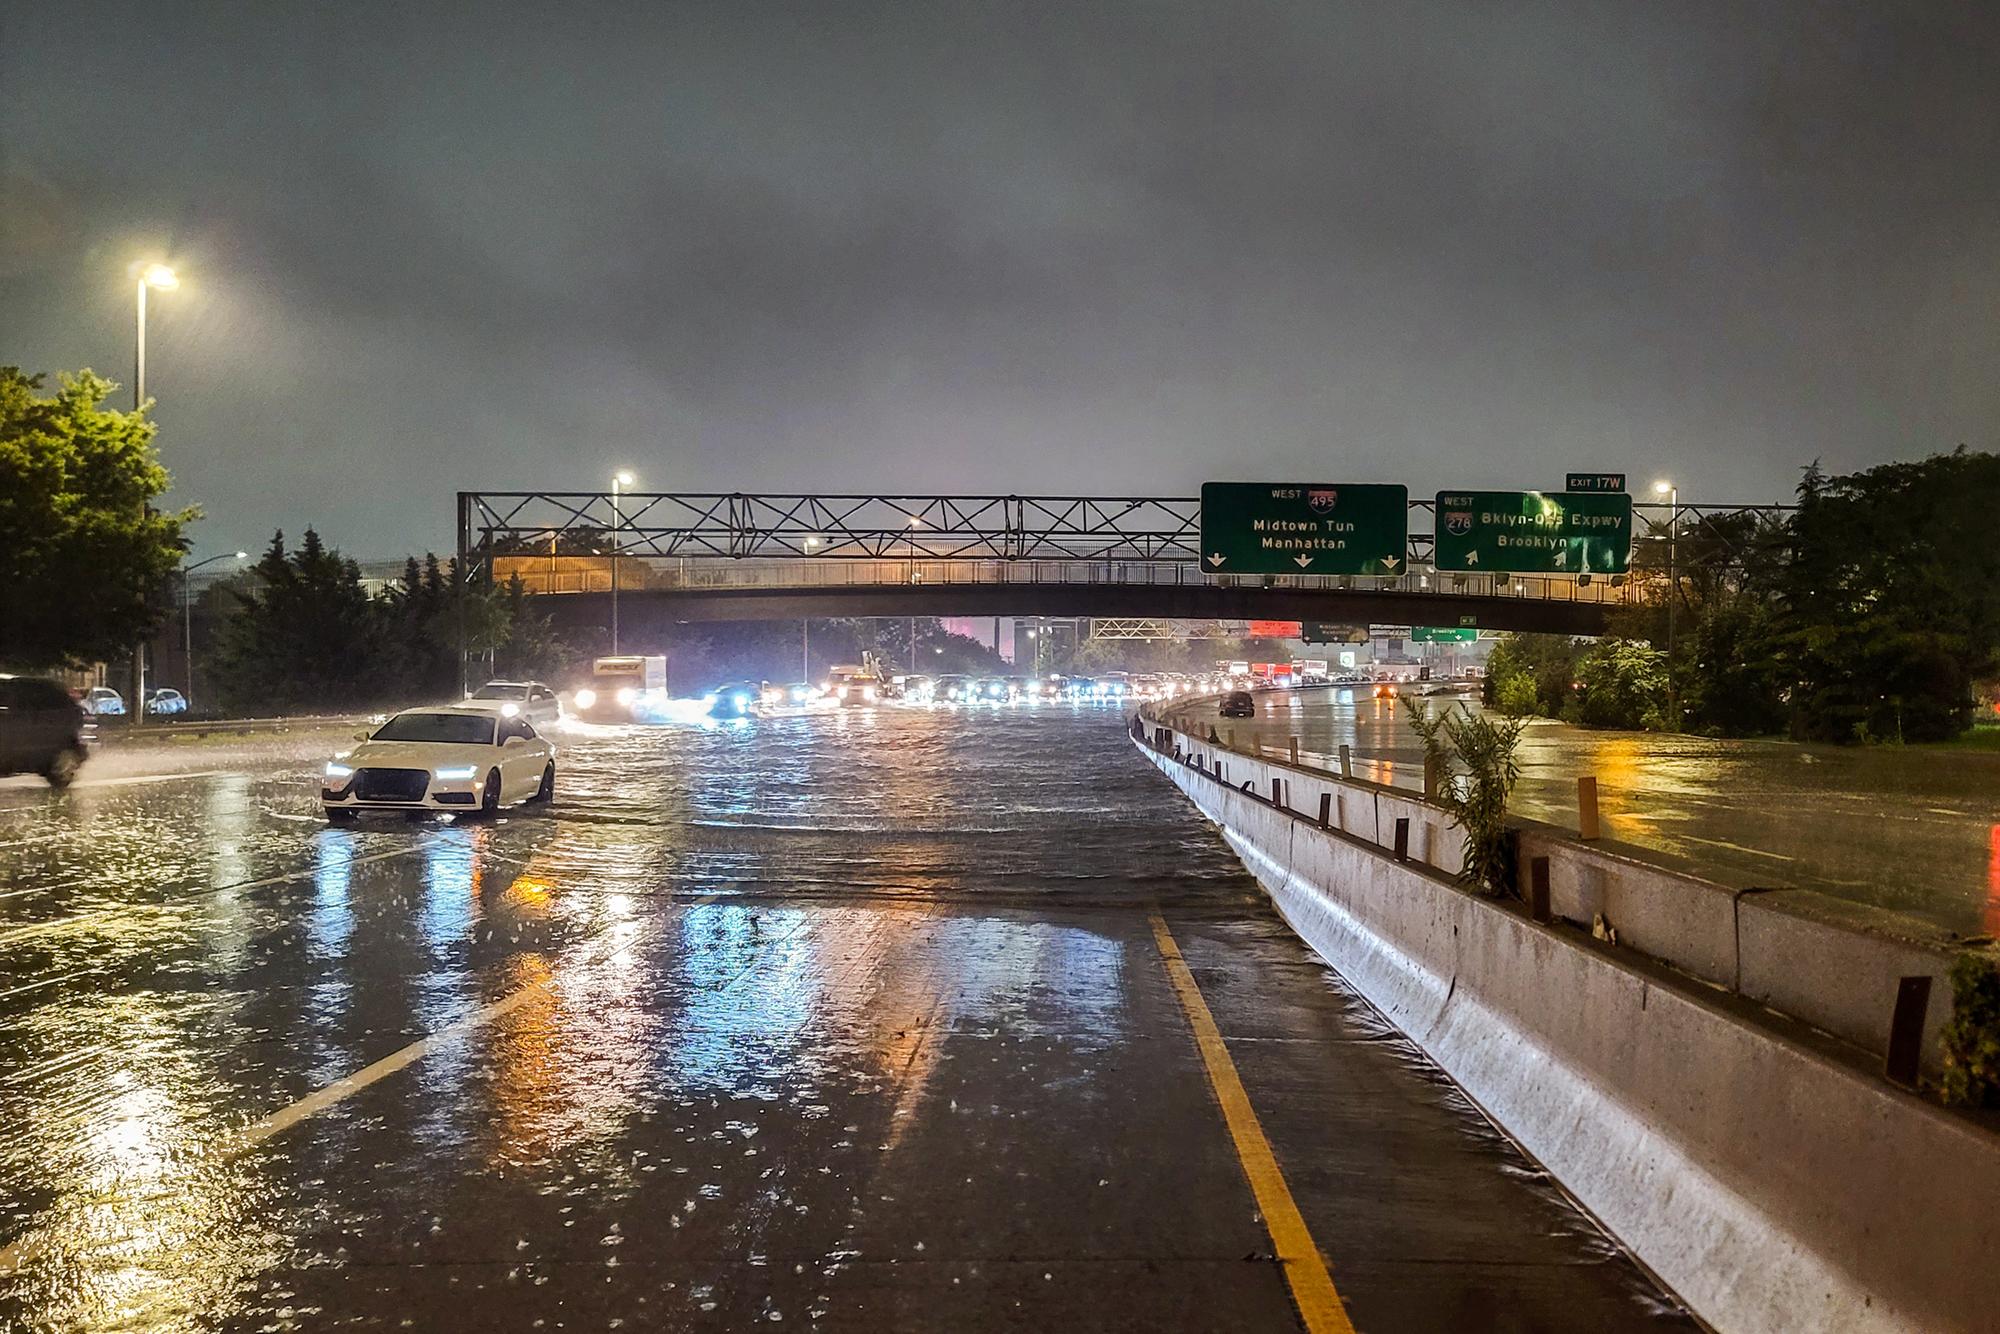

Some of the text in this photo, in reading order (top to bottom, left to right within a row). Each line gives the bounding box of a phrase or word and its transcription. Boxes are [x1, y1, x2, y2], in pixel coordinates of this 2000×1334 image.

[1570, 477, 1621, 489] EXIT 17W
[1271, 489, 1302, 499] WEST
[1311, 496, 1335, 507] 495
[1444, 496, 1474, 506] WEST
[1253, 519, 1354, 531] Midtown Tun
[1448, 518, 1472, 529] 278
[1571, 513, 1622, 529] Expwy
[1261, 537, 1346, 549] Manhattan
[1498, 535, 1567, 550] Brooklyn
